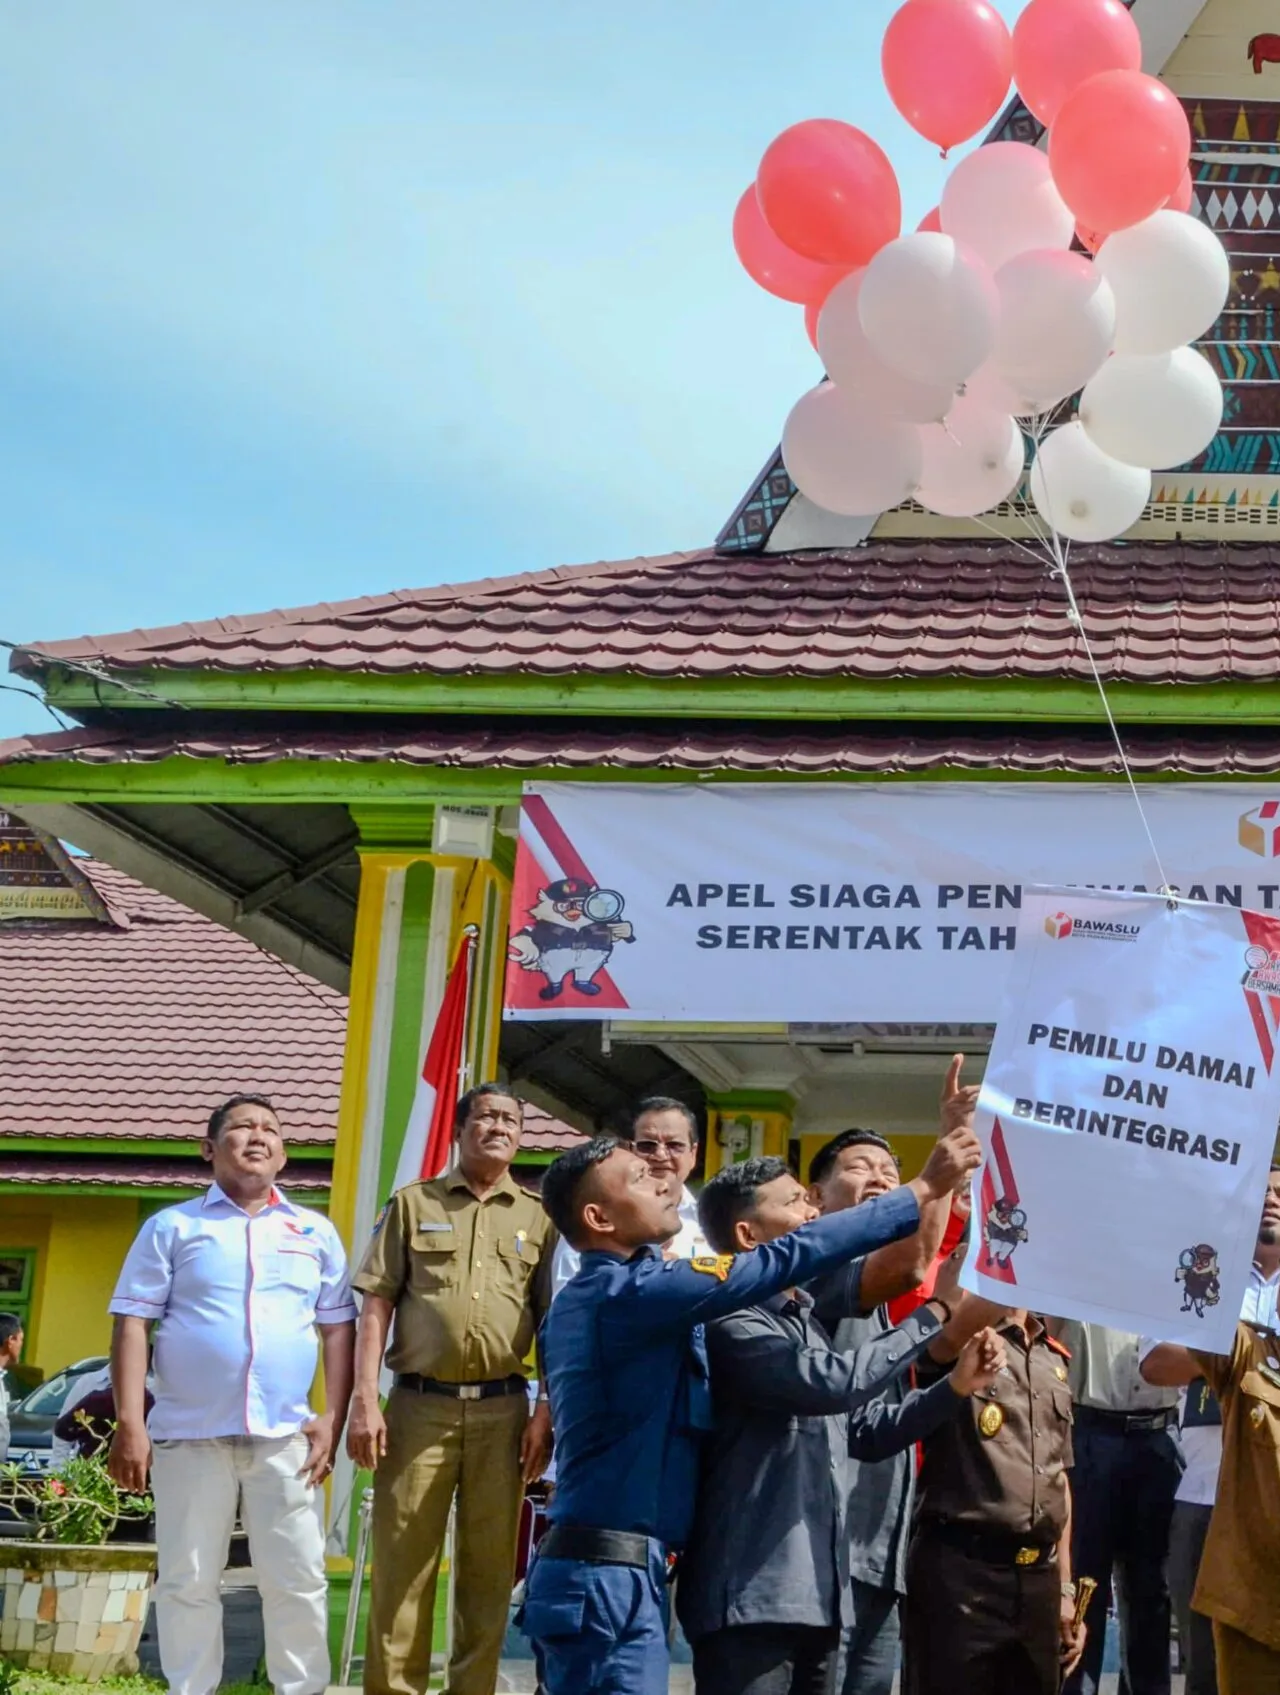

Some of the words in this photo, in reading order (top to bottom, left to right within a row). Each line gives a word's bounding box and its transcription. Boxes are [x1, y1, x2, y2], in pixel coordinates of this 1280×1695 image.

[666, 883, 776, 908] APEL
[788, 883, 922, 909] SIAGA
[695, 924, 923, 951] SERENTAK
[1073, 918, 1141, 935] BAWASLU
[1027, 1023, 1147, 1063] PEMILU
[1155, 1045, 1256, 1089] DAMAI
[1102, 1074, 1169, 1109] DAN
[1012, 1098, 1241, 1166] BERINTEGRASI
